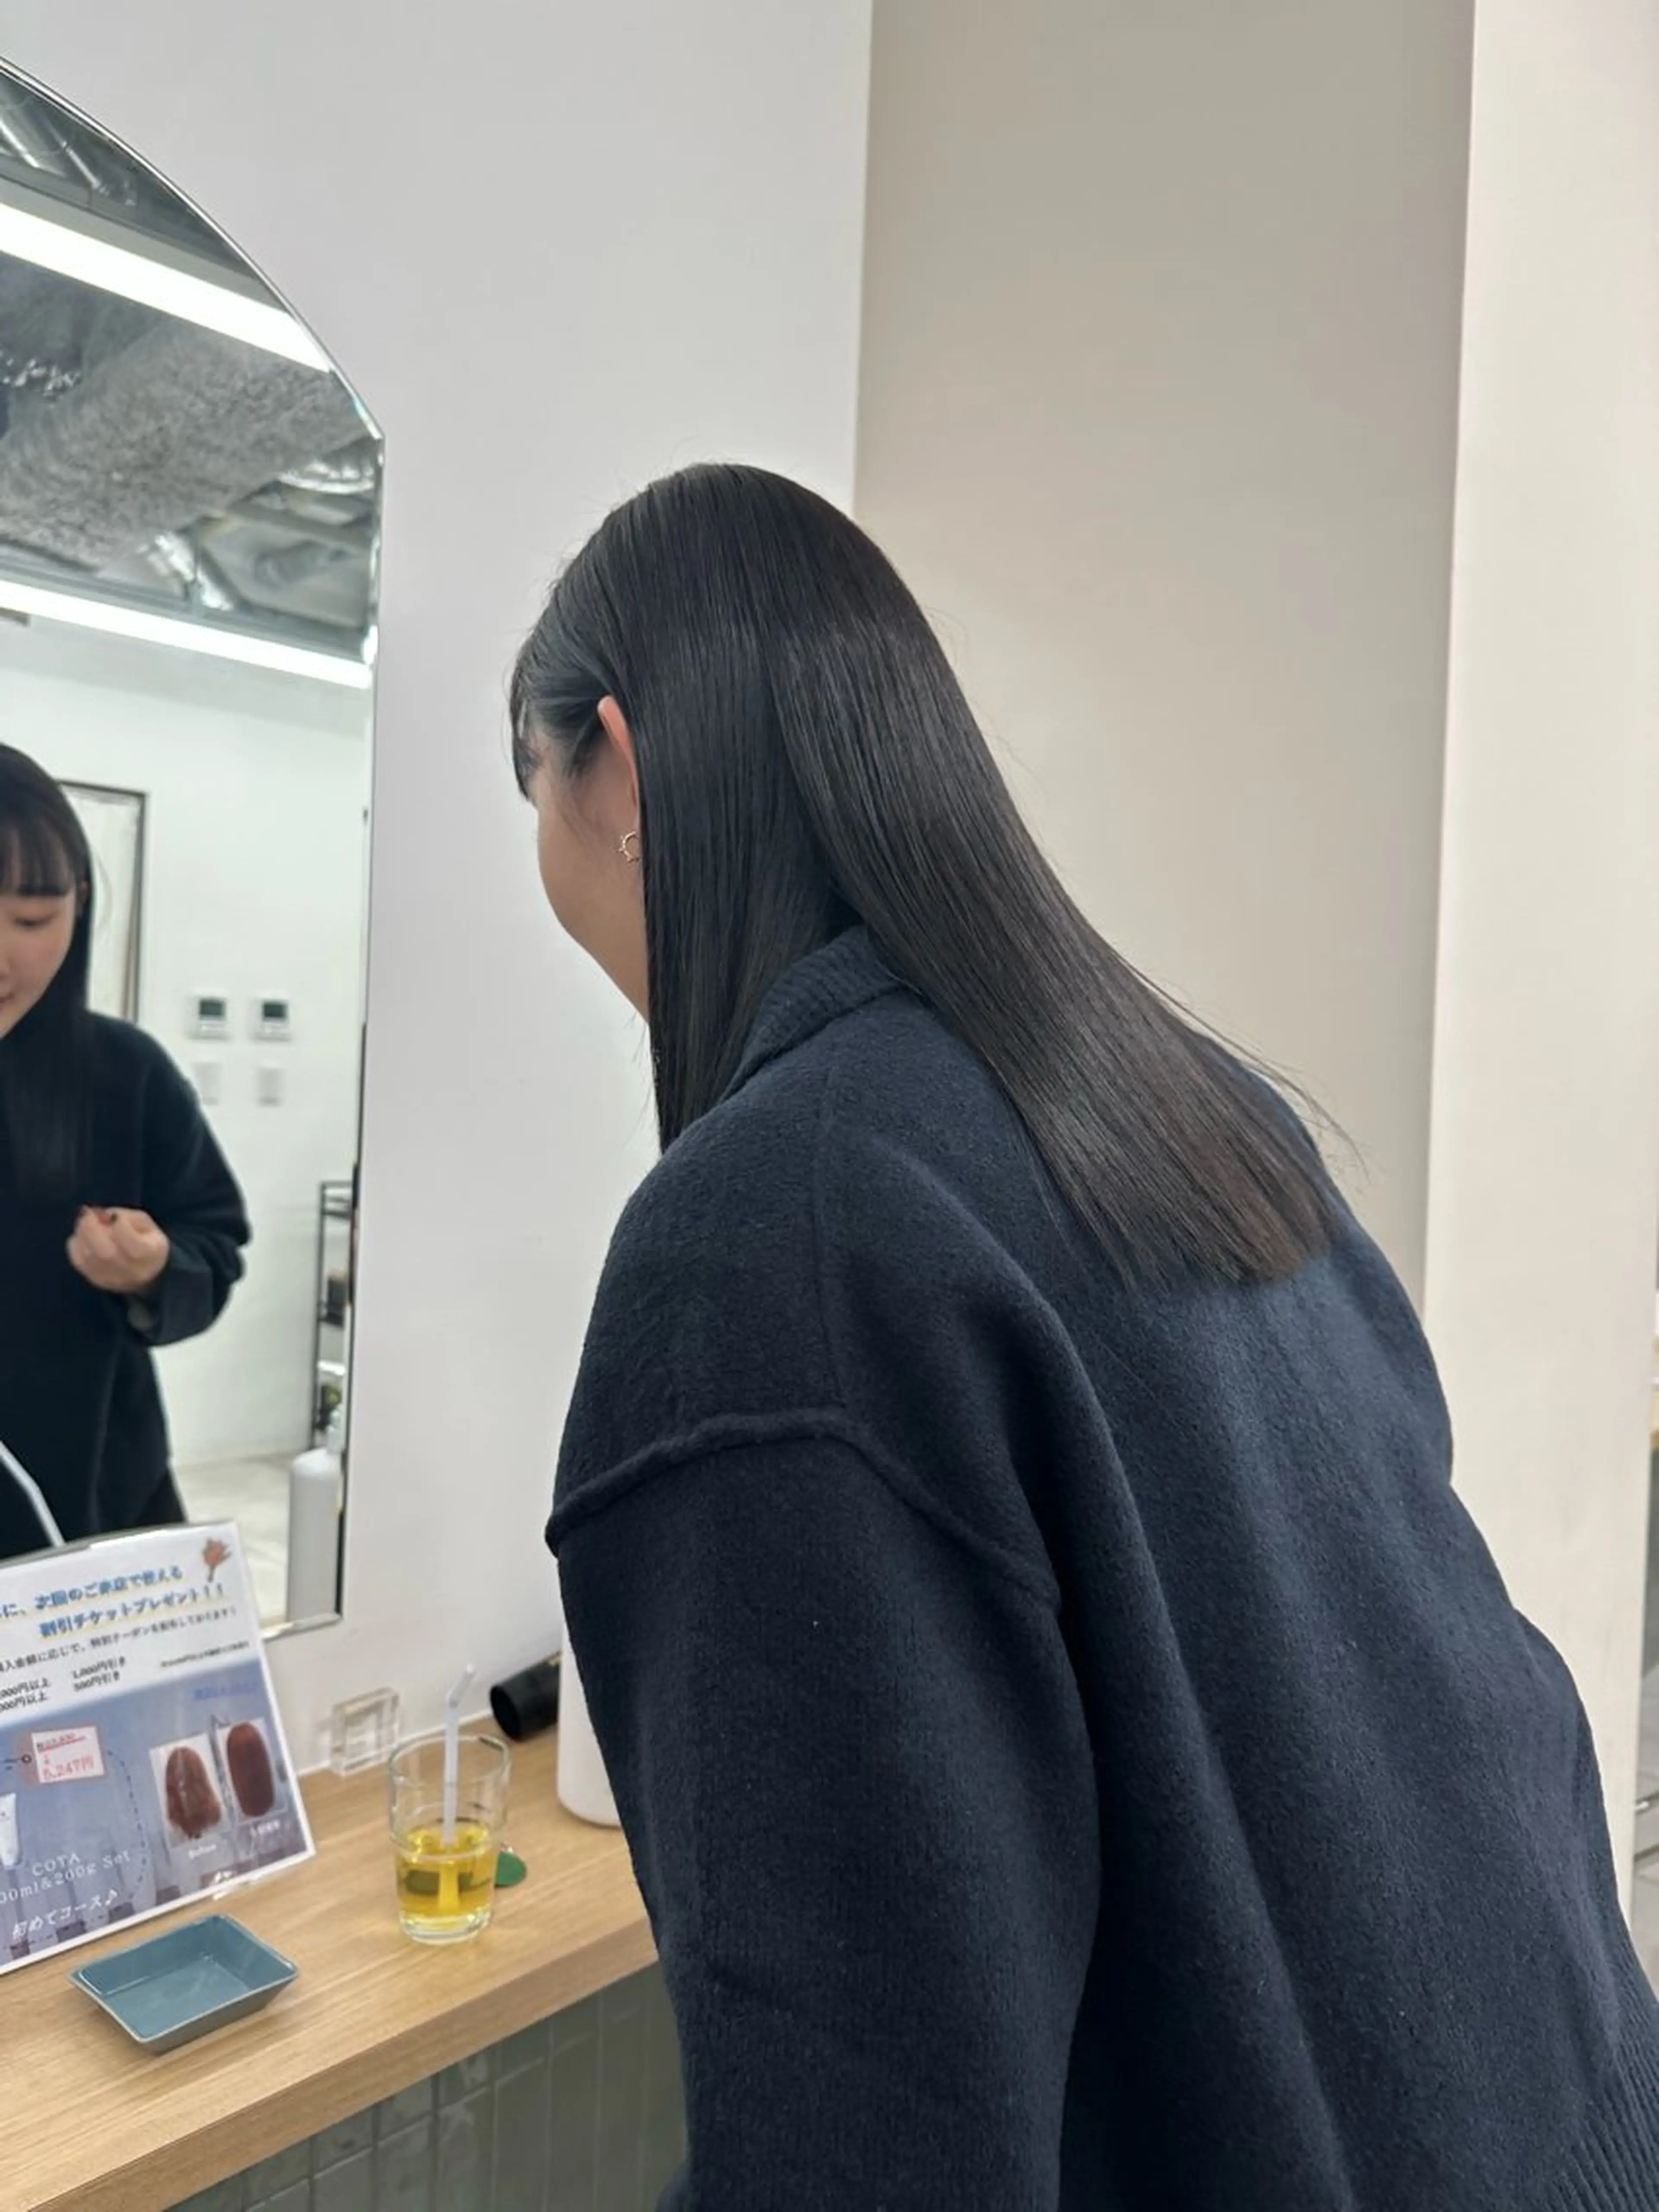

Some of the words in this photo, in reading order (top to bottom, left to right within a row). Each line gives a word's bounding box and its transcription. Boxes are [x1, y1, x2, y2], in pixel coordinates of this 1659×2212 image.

[0, 1566, 183, 1619] に、次回のご来店で使える
[32, 1852, 81, 1876] COTA
